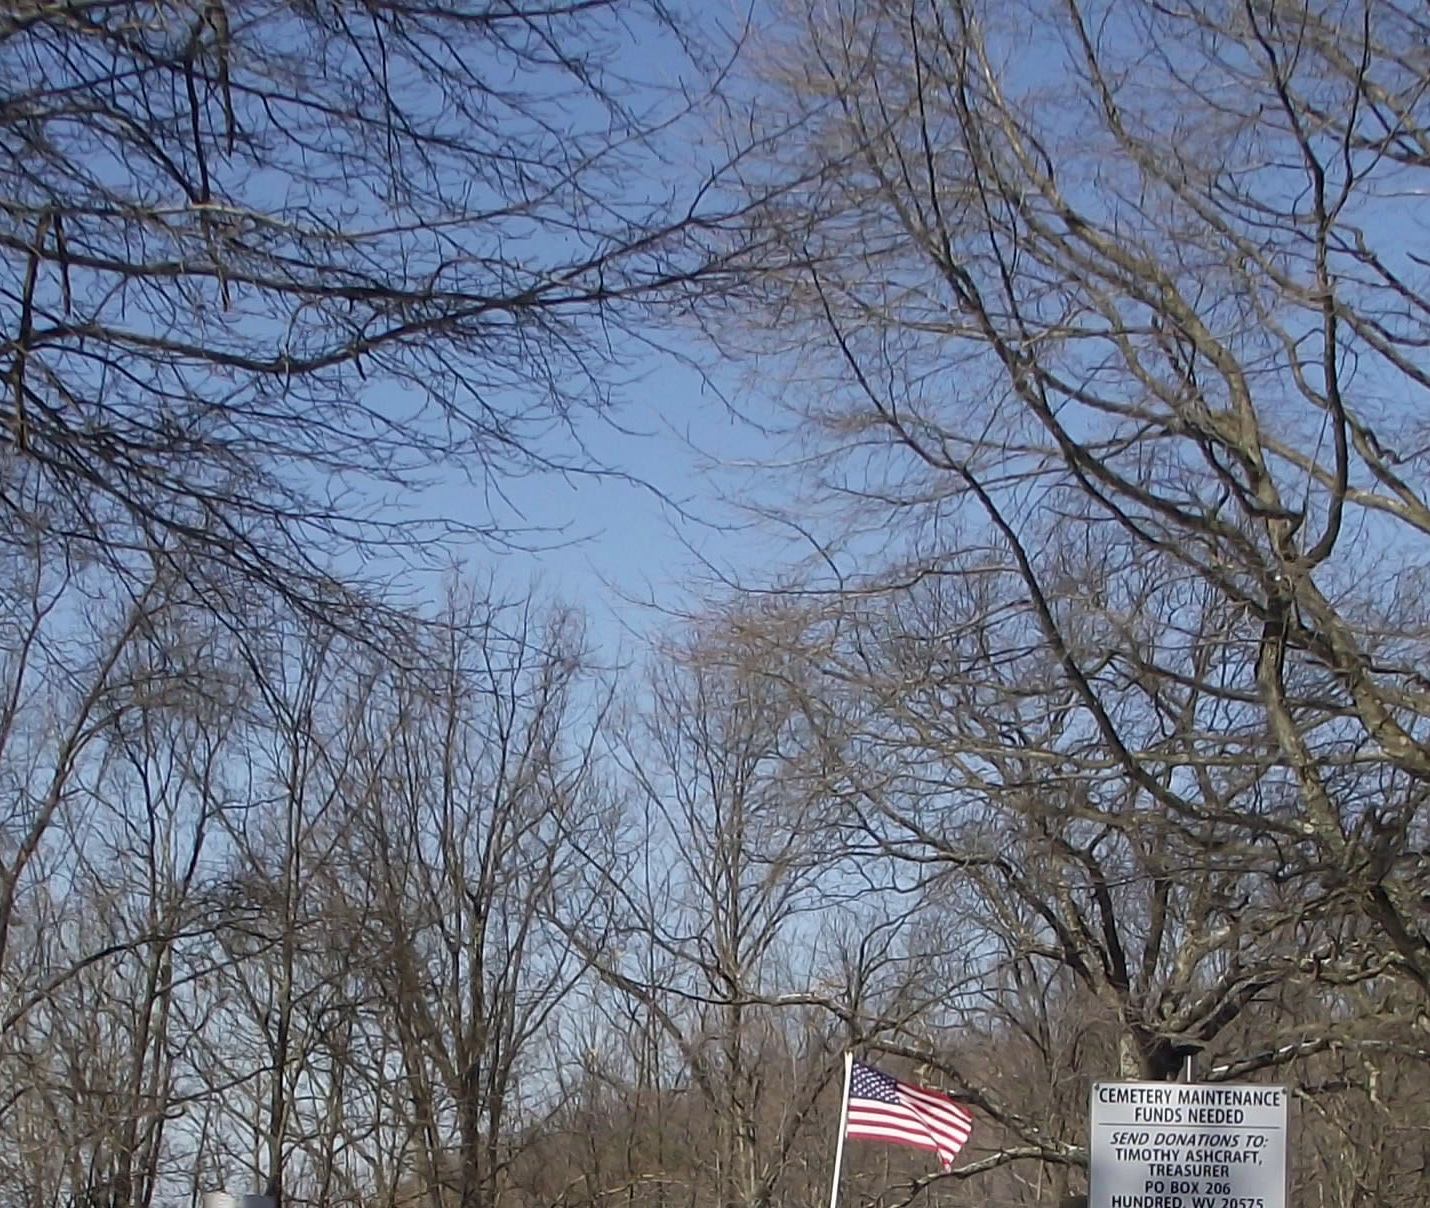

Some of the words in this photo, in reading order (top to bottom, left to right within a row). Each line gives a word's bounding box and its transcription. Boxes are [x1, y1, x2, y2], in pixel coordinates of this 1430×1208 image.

[1099, 1088, 1172, 1103] CEMETERY
[1178, 1089, 1279, 1107] MAINTENANCE
[1135, 1107, 1182, 1122] FUNDS
[1188, 1109, 1244, 1124] NEEDED
[1110, 1132, 1149, 1145] SEND
[1154, 1134, 1239, 1147] DONATIONS
[1246, 1136, 1268, 1148] TO:
[1115, 1149, 1179, 1161] TIMOTHY
[1186, 1150, 1262, 1166] ASHCRAFT,
[1149, 1164, 1229, 1177] TREASURER
[1145, 1181, 1164, 1193] PO
[1171, 1182, 1199, 1194] BOX
[1206, 1183, 1231, 1195] 206
[1192, 1198, 1215, 1208] WV
